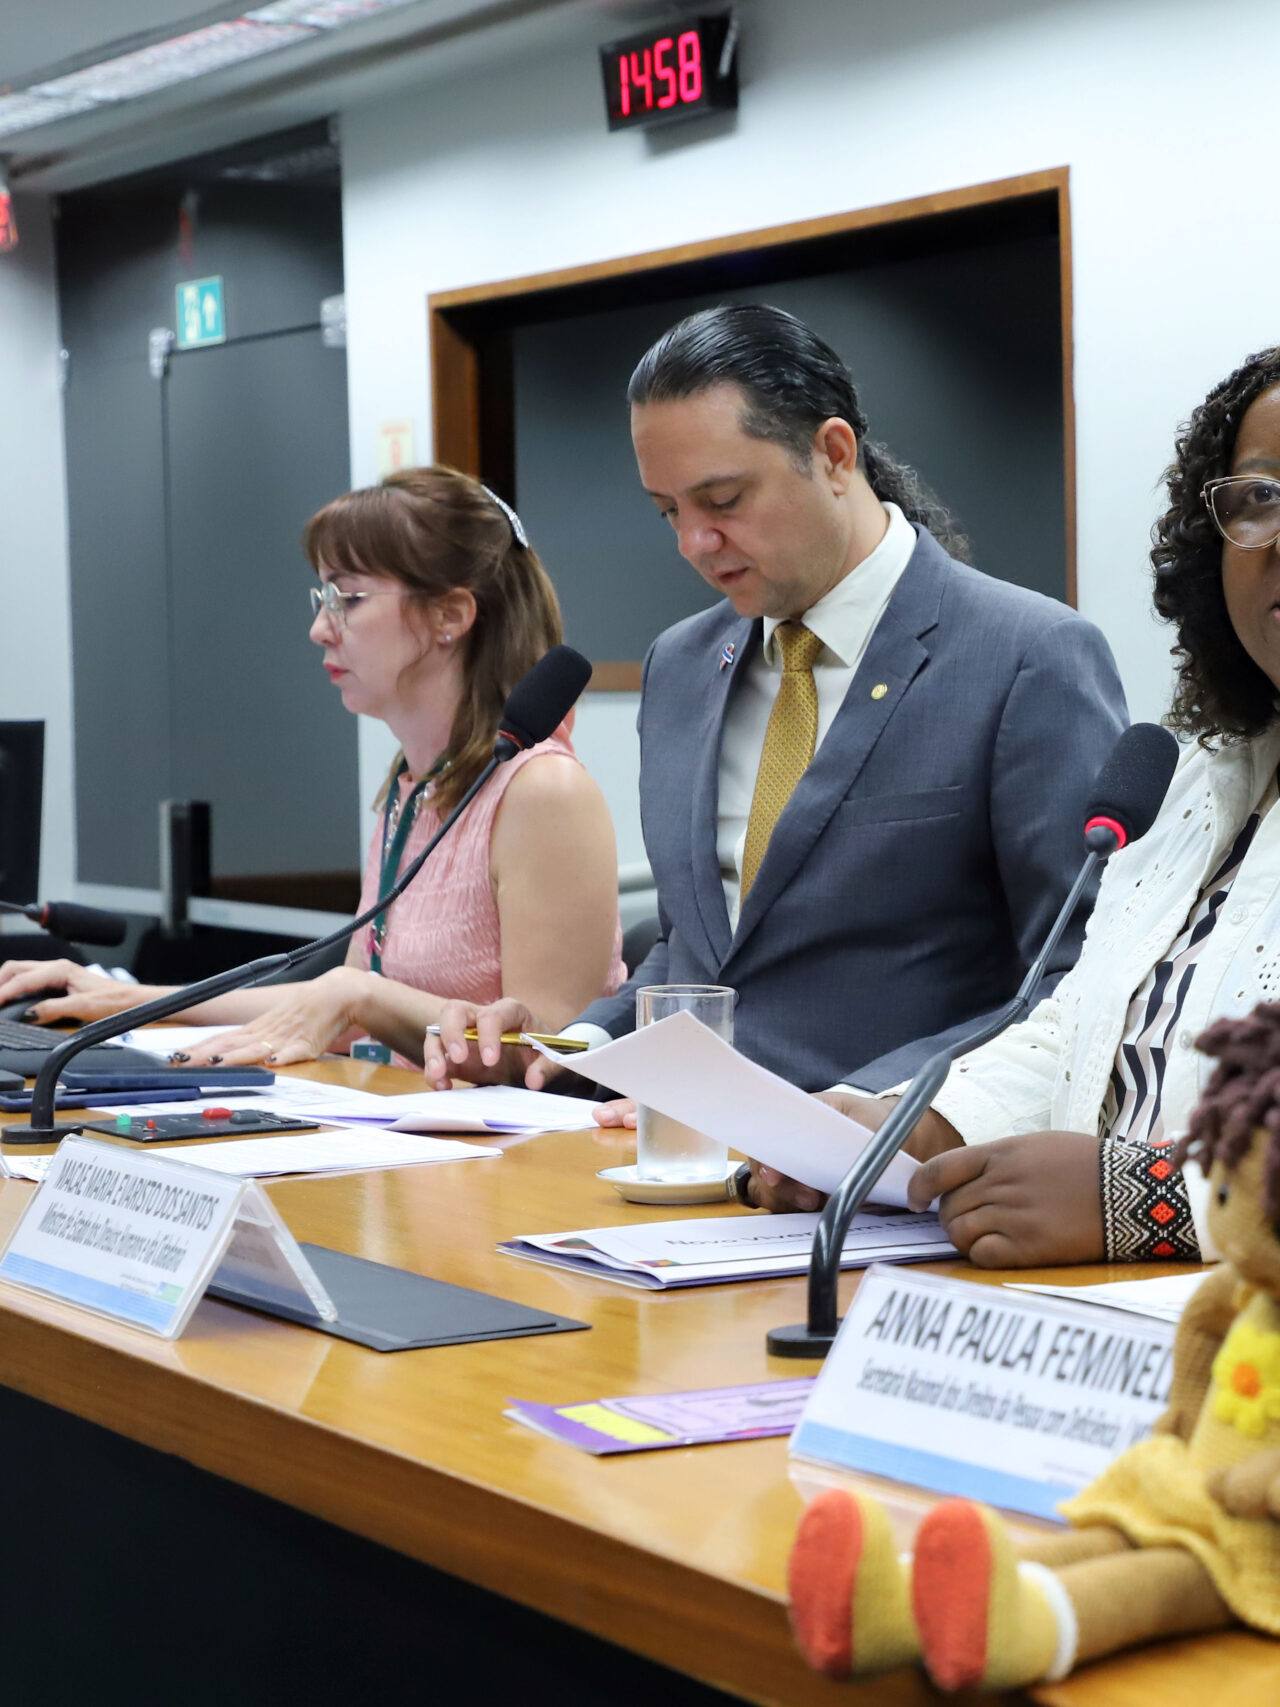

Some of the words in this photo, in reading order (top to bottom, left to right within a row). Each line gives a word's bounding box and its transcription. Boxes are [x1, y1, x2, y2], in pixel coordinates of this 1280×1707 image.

[54, 1156, 97, 1196] MACAÉ
[83, 1166, 121, 1204] MARIA
[111, 1174, 162, 1215] EVARISTO
[152, 1184, 183, 1220] DOS
[172, 1190, 220, 1231] SANTOS
[864, 1290, 953, 1352] ANNA
[946, 1305, 1046, 1376] PAULA
[1039, 1324, 1172, 1402] FEMINEL
